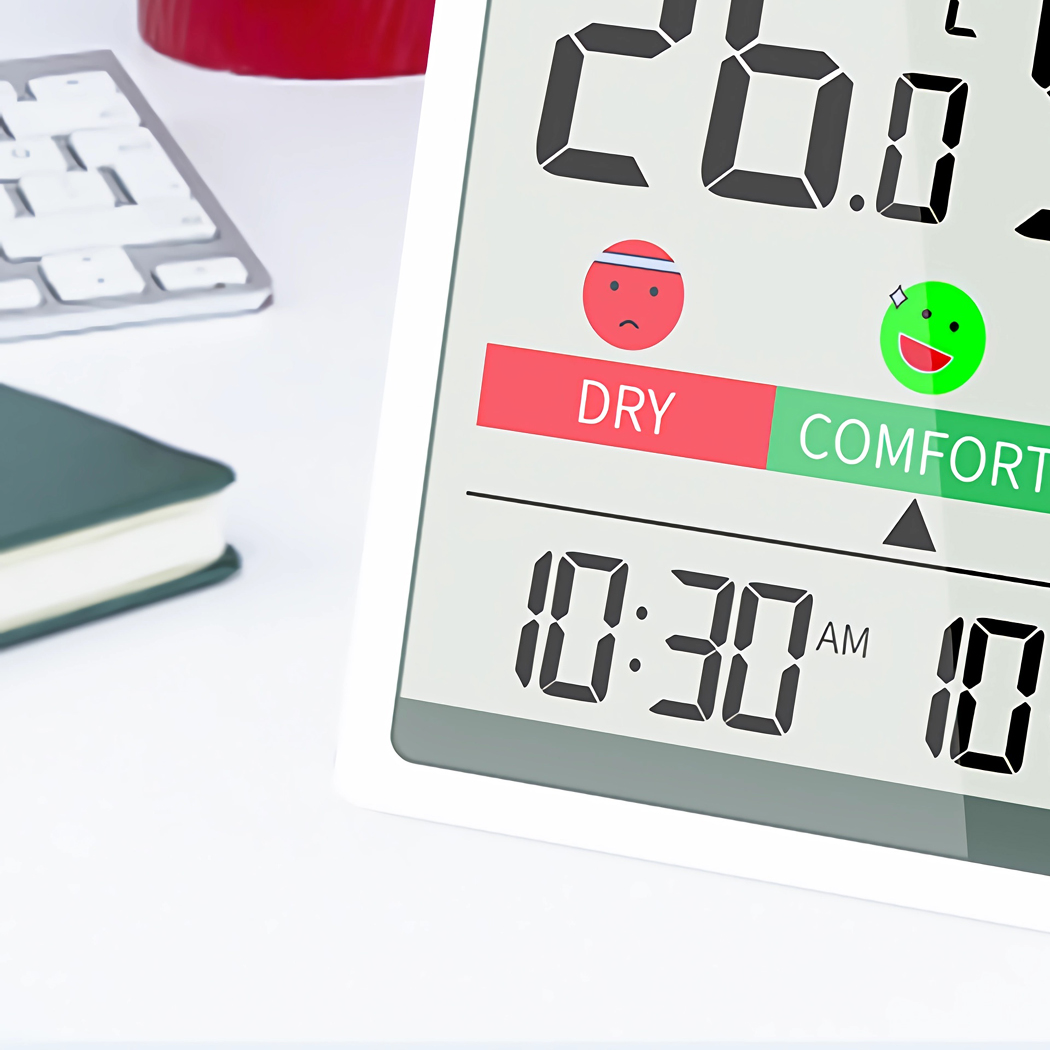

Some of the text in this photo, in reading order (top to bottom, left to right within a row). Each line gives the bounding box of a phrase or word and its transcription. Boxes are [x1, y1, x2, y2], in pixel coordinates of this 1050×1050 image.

[577, 379, 676, 435] DRY
[514, 550, 870, 737] 10:30 AM
